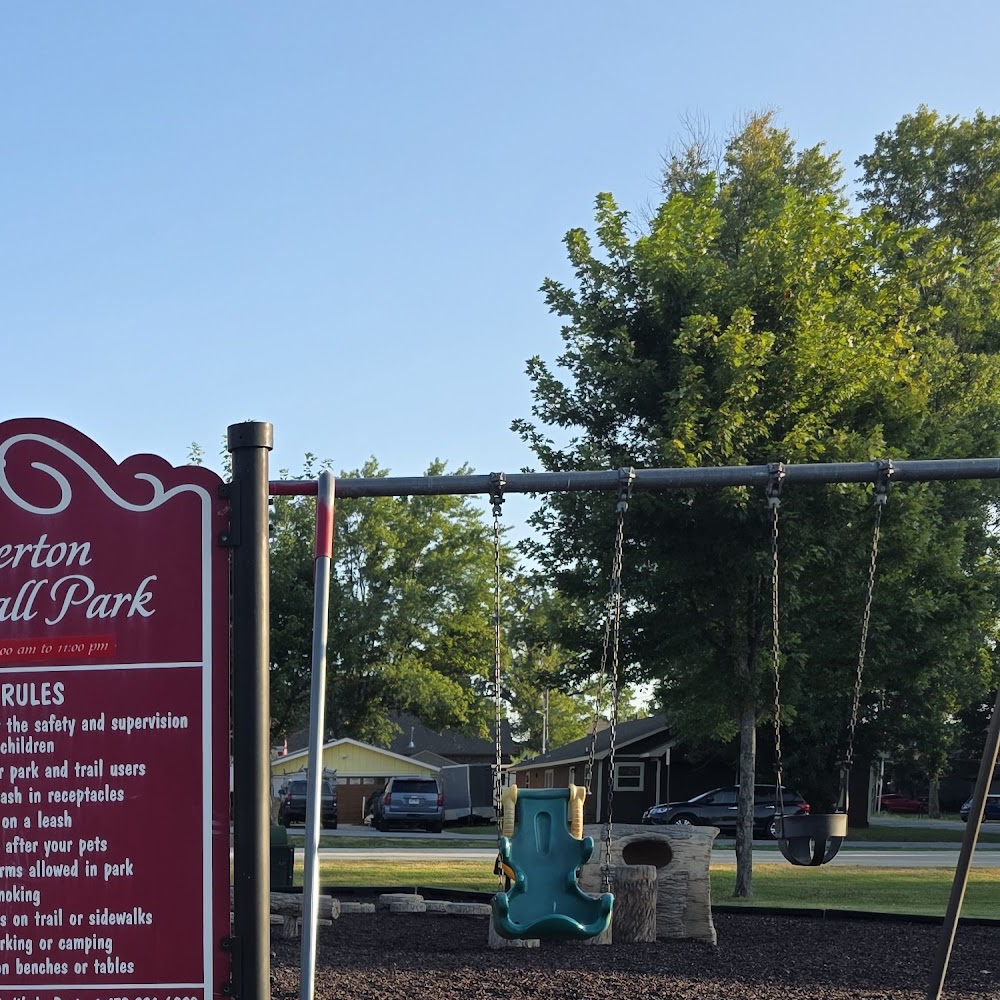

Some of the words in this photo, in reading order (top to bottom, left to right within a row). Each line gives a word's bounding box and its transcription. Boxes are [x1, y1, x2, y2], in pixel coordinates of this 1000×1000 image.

[45, 574, 157, 625] Park
[17, 646, 36, 655] am
[41, 644, 52, 653] to
[58, 644, 85, 653] 11:00
[88, 643, 108, 655] pm
[2, 682, 64, 707] RULES
[6, 715, 28, 733] the
[34, 714, 76, 737] safety
[82, 712, 105, 731] and
[111, 712, 188, 735] supervision
[0, 736, 54, 754] children
[10, 760, 39, 784] park
[45, 759, 68, 778] and
[74, 758, 103, 779] trail
[110, 763, 146, 777] users
[29, 787, 41, 804] in
[48, 784, 124, 808] receptacles
[2, 816, 17, 829] on
[24, 816, 31, 828] a
[38, 810, 72, 828] leash
[6, 836, 38, 853] after
[44, 840, 73, 858] your
[79, 836, 107, 857] pets
[29, 859, 78, 878] allowed
[85, 860, 97, 877] in
[104, 858, 133, 881] park
[13, 914, 28, 927] on
[34, 908, 62, 926] trail
[69, 914, 83, 926] or
[89, 907, 152, 925] sidewalks
[39, 938, 53, 951] or
[58, 933, 112, 955] camping
[16, 957, 68, 975] benches
[74, 962, 88, 974] or
[94, 956, 134, 974] tables
